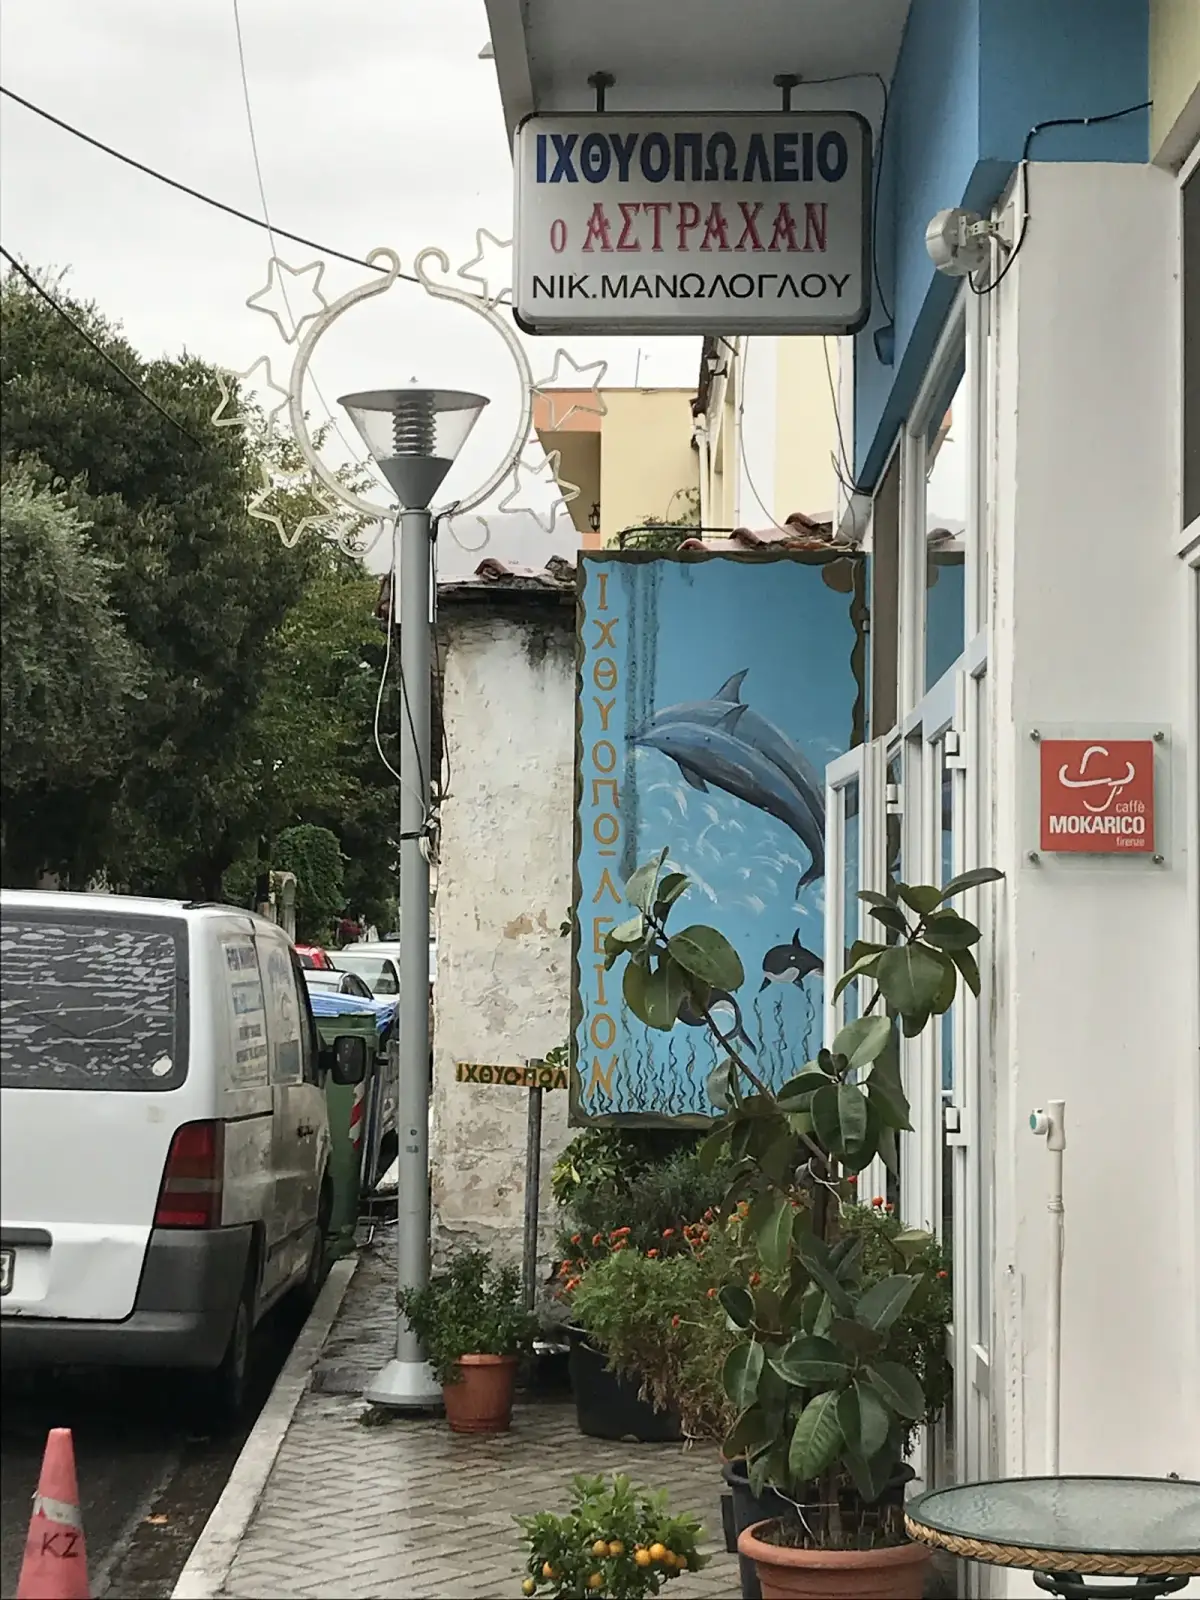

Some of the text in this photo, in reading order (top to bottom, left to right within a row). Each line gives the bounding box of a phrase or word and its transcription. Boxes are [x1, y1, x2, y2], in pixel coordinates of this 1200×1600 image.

[536, 131, 848, 183] ΙΧΘΥΟΠΩΛΕΙΟ
[582, 202, 828, 253] ΑΣΤΡΑΧΑΝ
[1115, 800, 1145, 813] caffè
[1049, 815, 1145, 834] MOKARICO
[1116, 836, 1145, 847] firenze
